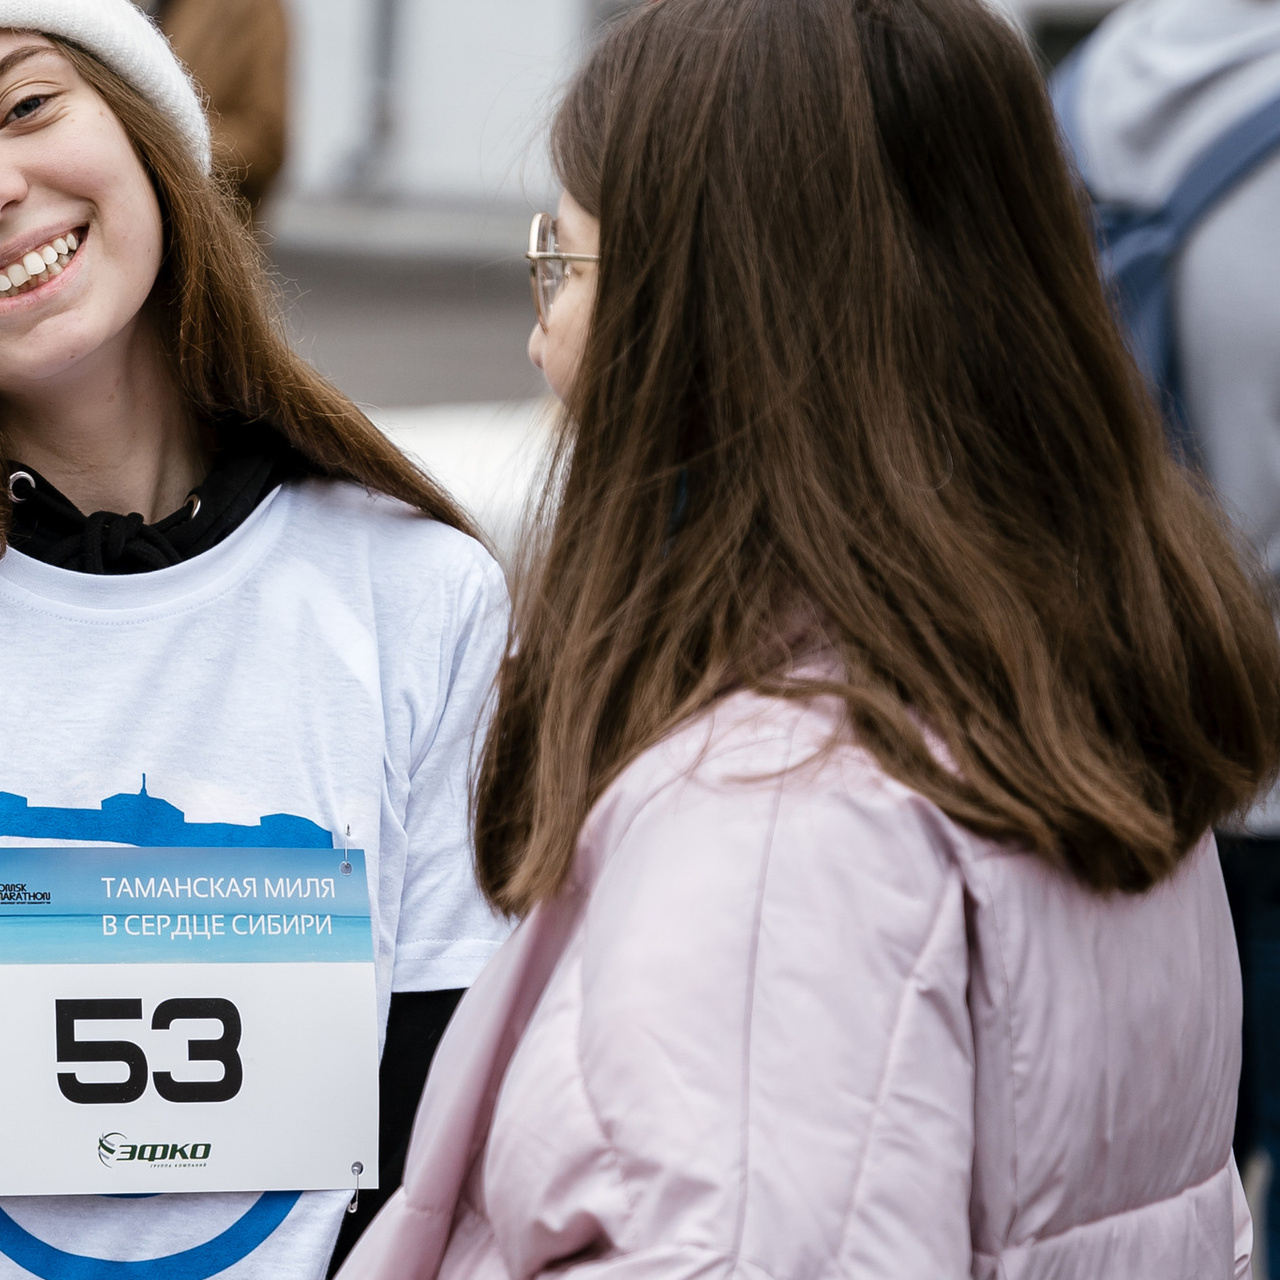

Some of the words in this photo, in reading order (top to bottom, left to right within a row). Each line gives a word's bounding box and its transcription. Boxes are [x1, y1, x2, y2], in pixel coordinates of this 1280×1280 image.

[101, 877, 257, 898] ТАМАНСКАЯ
[264, 877, 335, 898] МИЛЯ
[102, 915, 117, 936] В
[124, 915, 225, 940] СЕРДЦЕ
[232, 915, 332, 936] СИБИРИ
[55, 997, 243, 1104] 53
[115, 1143, 212, 1162] ЭФКО
